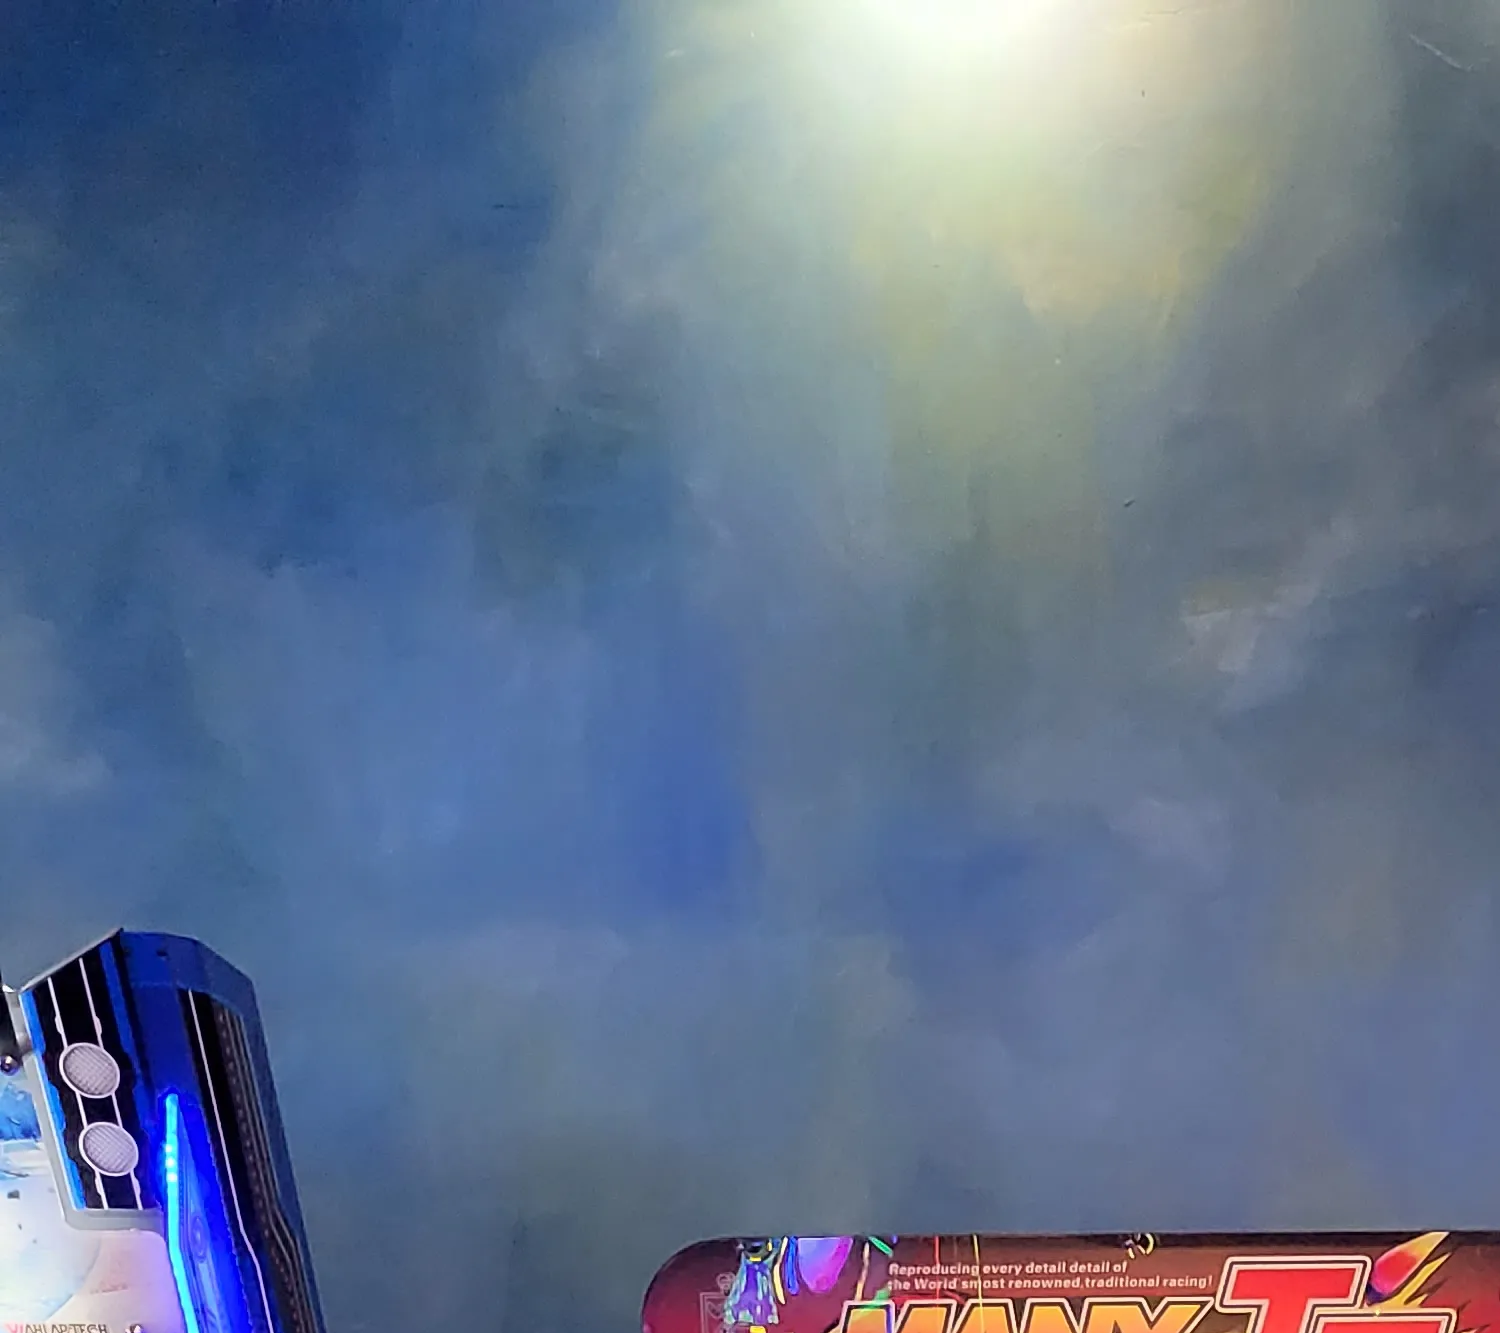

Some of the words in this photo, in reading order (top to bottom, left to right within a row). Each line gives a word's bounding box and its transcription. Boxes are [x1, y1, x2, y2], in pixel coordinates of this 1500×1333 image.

[889, 1262, 980, 1277] Reproducing
[983, 1263, 1023, 1276] every
[1025, 1261, 1067, 1274] detail
[1069, 1260, 1111, 1273] detail
[1113, 1261, 1128, 1273] of
[1162, 1274, 1213, 1289] racing!
